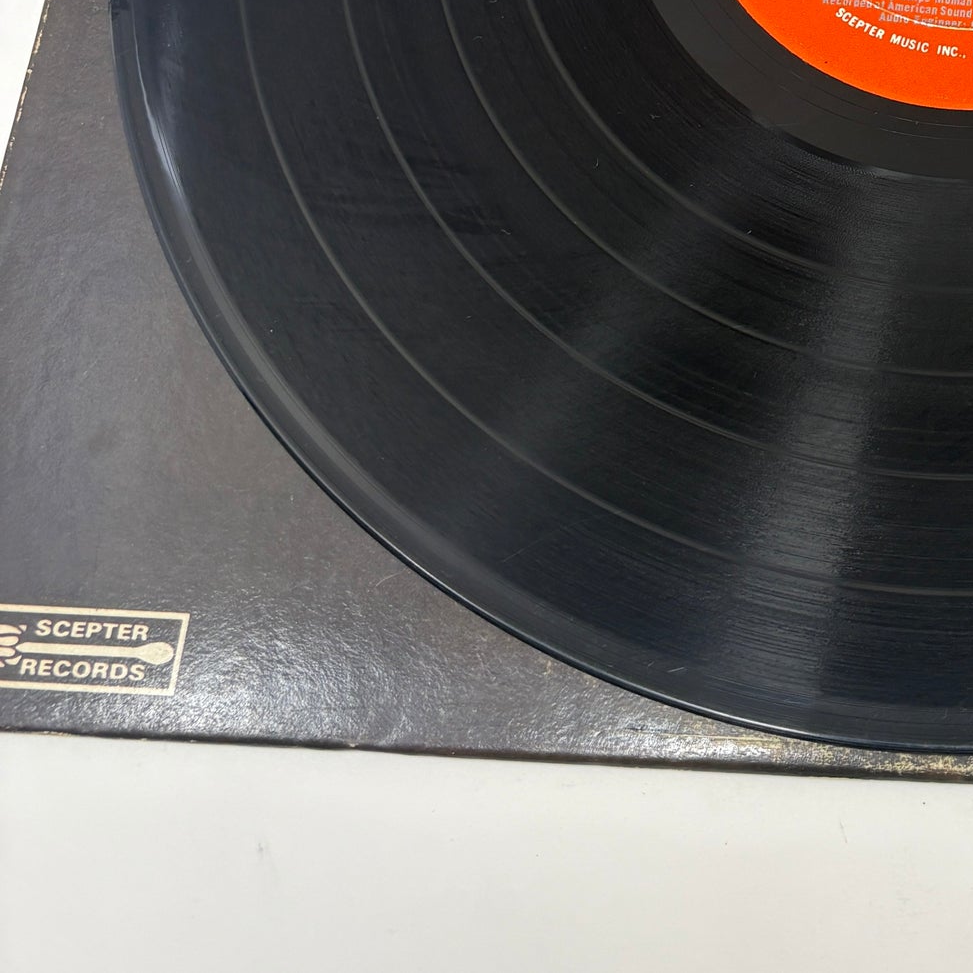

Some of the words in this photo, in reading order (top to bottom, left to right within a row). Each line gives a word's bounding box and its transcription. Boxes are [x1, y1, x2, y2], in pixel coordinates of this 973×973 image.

[878, 12, 910, 25] Audio
[887, 0, 938, 16] American
[940, 4, 973, 19] Sound
[834, 7, 886, 40] SCEPTER
[889, 32, 930, 54] MUSIC
[936, 44, 967, 59] INC.,
[34, 618, 150, 641] SCEPTER
[19, 657, 146, 682] RECORDS
